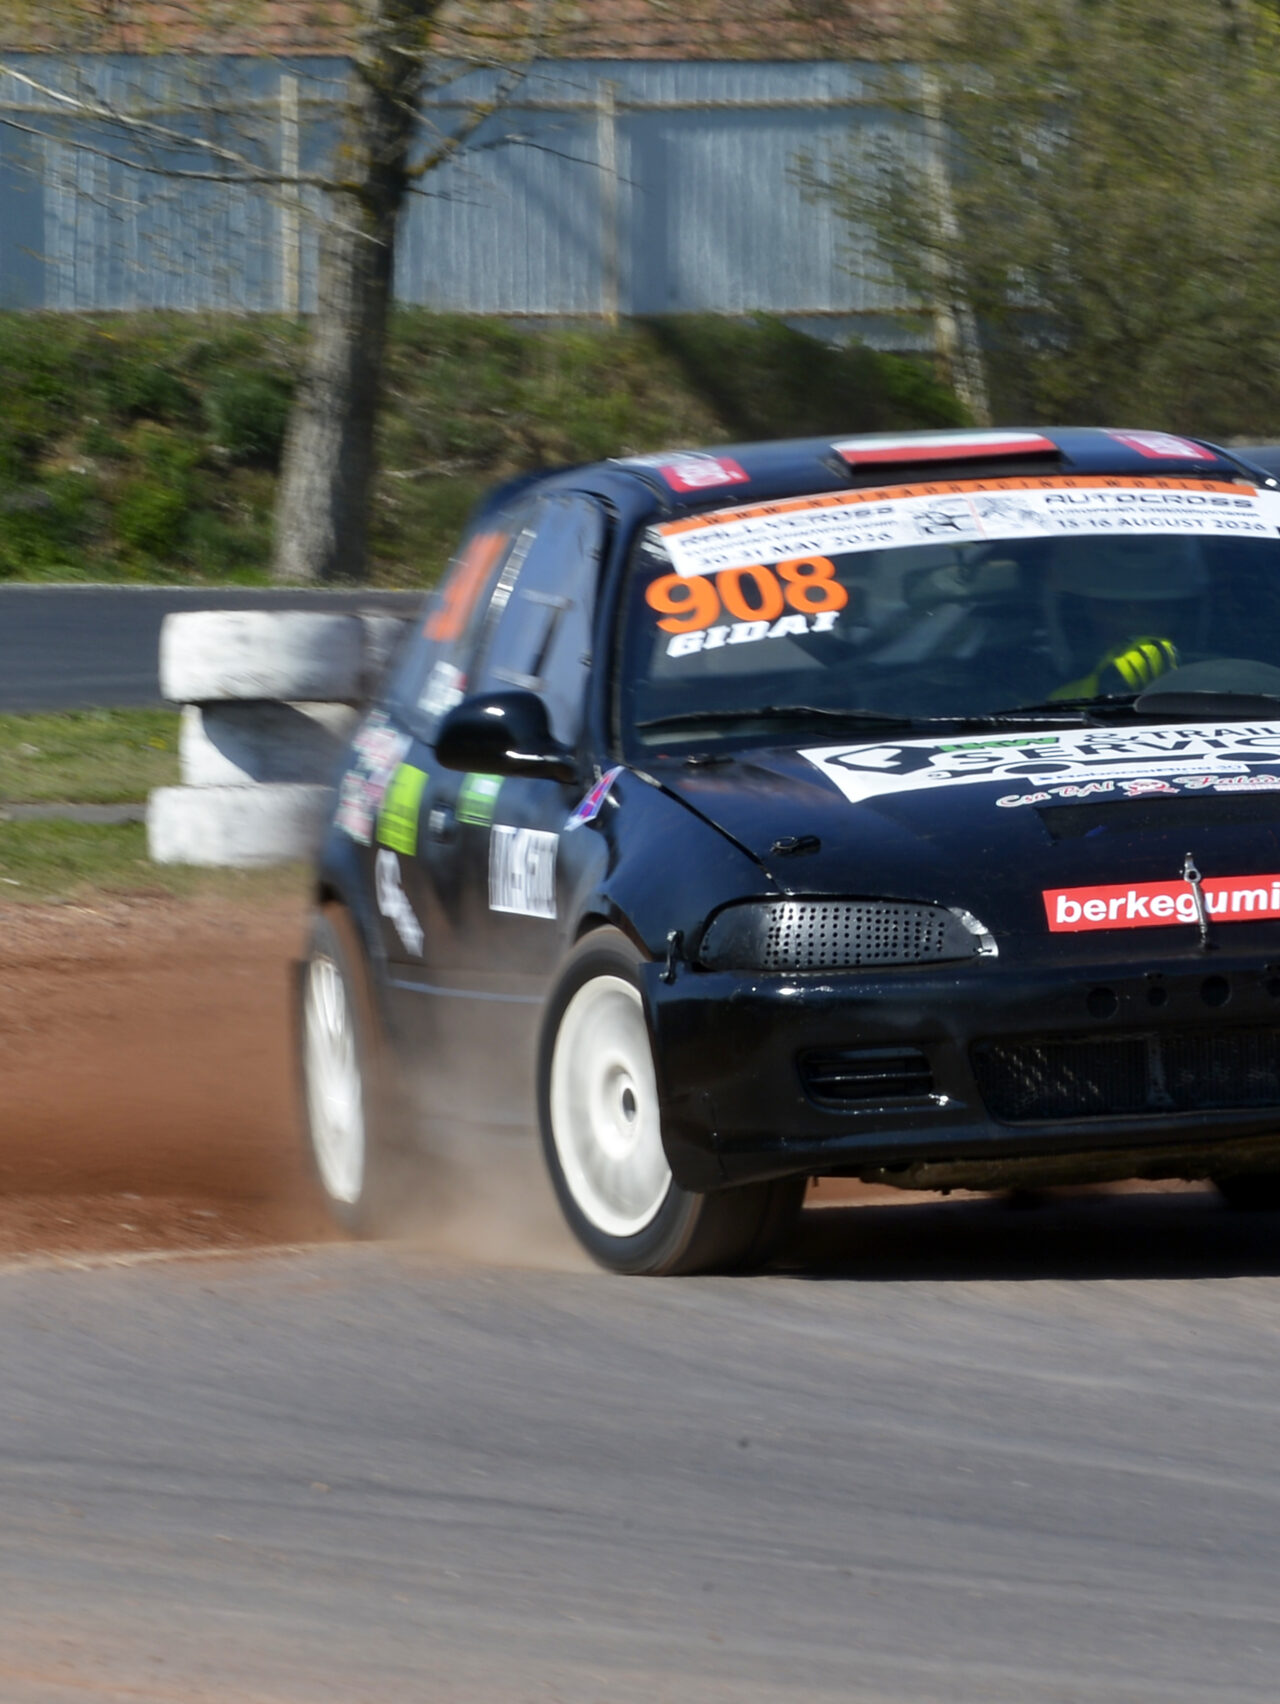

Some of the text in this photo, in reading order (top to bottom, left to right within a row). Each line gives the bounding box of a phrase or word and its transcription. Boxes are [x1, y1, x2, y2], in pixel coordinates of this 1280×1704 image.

[1044, 492, 1254, 508] AUTOCROSS
[1118, 517, 1205, 528] AUGUST
[1214, 518, 1268, 532] 2026
[771, 539, 821, 554] MAY
[645, 556, 849, 634] 908
[667, 611, 840, 658] GIDAI
[1084, 732, 1139, 743] &
